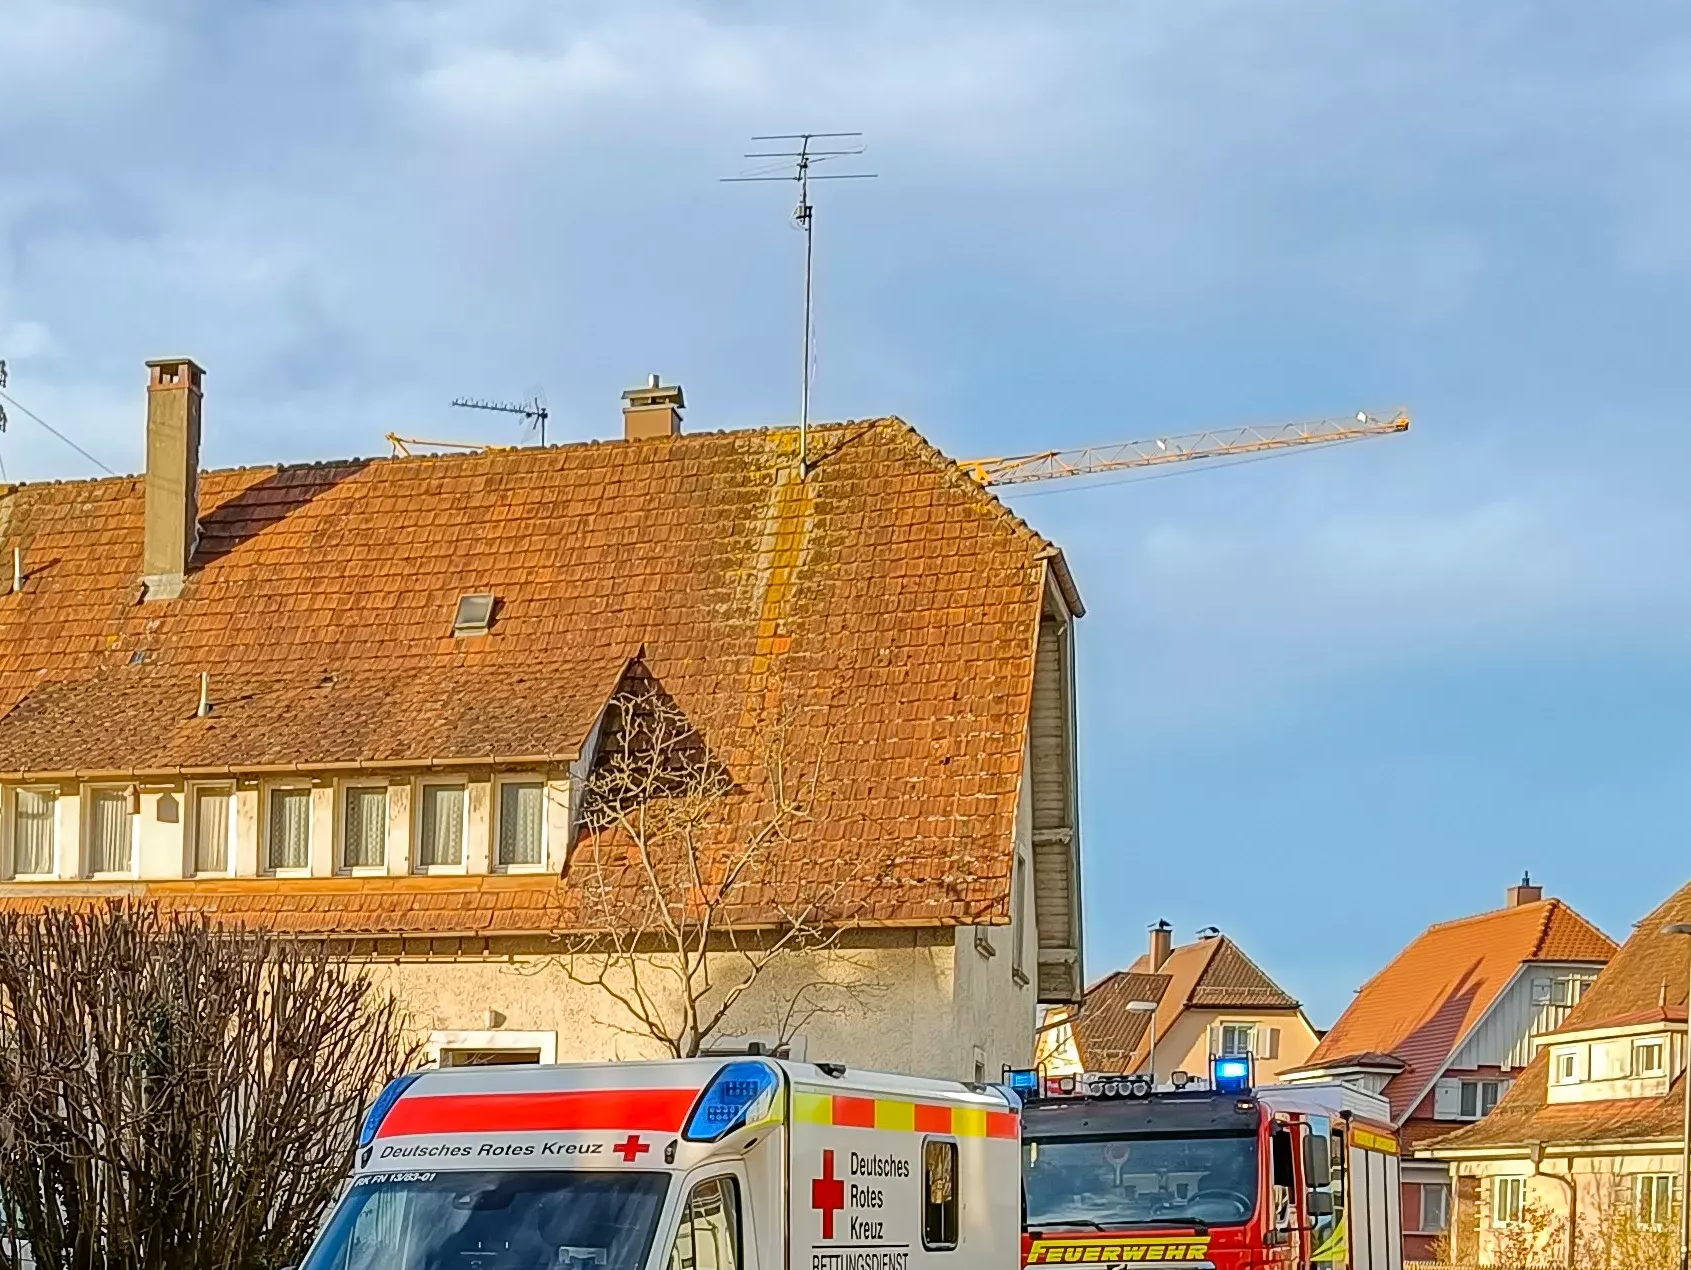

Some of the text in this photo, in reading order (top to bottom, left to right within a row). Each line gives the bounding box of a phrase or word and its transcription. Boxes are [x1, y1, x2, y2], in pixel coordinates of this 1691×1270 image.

[380, 1140, 603, 1159] Deutsches Rotes Kreuz
[850, 1151, 909, 1178] Deutsches
[371, 1174, 388, 1184] FN
[850, 1184, 883, 1208] Rotes
[850, 1216, 883, 1240] Kreuz
[1027, 1236, 1211, 1263] FEUERWEHR
